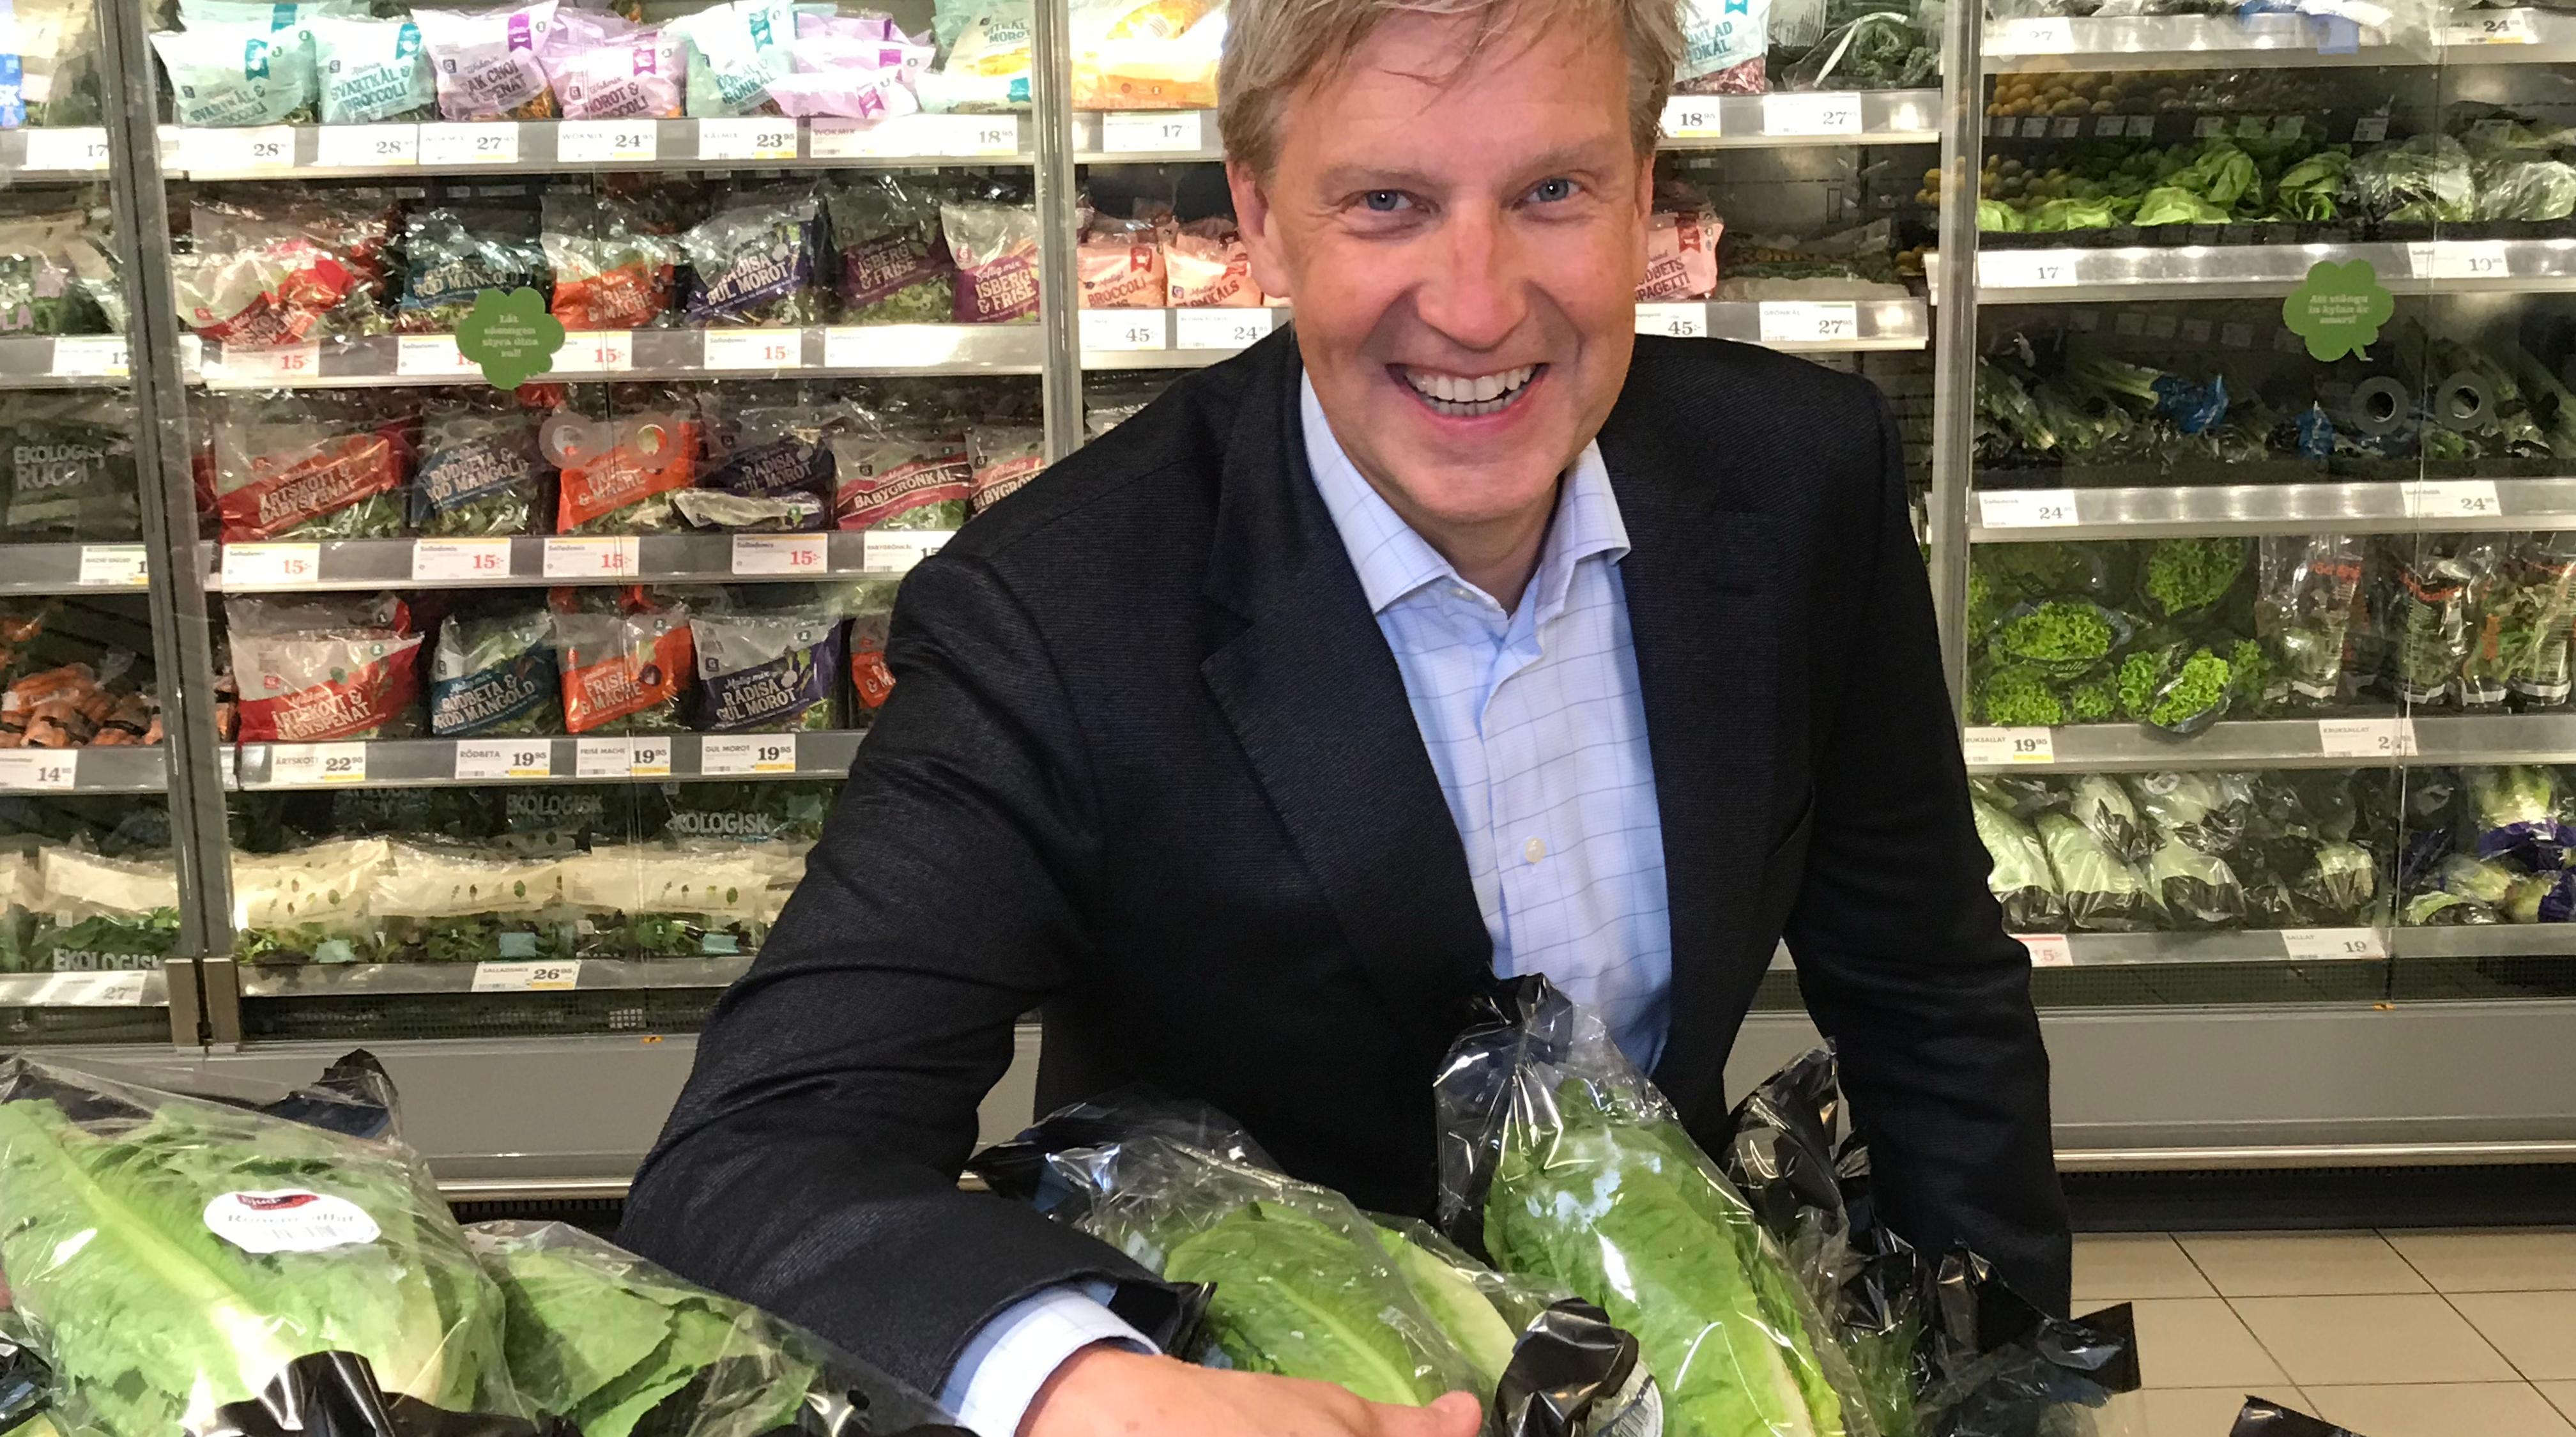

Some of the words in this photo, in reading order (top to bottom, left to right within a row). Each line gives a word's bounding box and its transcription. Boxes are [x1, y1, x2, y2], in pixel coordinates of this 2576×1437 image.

[2483, 19, 2510, 33] 24
[330, 67, 399, 102] SVARTKÅL
[628, 81, 640, 95] &
[1680, 112, 1703, 127] 18
[1822, 111, 1848, 125] 27
[978, 130, 1002, 144] 18
[1161, 125, 1183, 138] 17
[375, 140, 402, 155] 28
[475, 136, 503, 150] 27
[614, 133, 641, 148] 24
[756, 132, 783, 148] 23
[87, 144, 109, 158] 17
[253, 142, 280, 157] 28
[2036, 266, 2060, 280] 17
[706, 283, 737, 306] GUL
[735, 261, 789, 295] MOROT
[974, 268, 1032, 300] ISBERG
[1087, 276, 1147, 307] BROCCOLI
[2309, 294, 2327, 304] Att
[977, 298, 990, 314] &
[1233, 326, 1259, 341] 24
[1818, 319, 1843, 334] 27
[454, 458, 531, 493] MANGOLD
[765, 460, 813, 488] MOROT
[853, 468, 956, 509] BABYGRÖNKÅL
[2460, 497, 2487, 511] 24
[2038, 506, 2064, 520] 24
[348, 689, 362, 705] &
[441, 679, 505, 714] RÖDBETA
[503, 673, 518, 689] &
[721, 677, 781, 707] RADISA
[468, 679, 537, 722] MANGOLD
[716, 704, 746, 723] GUL
[745, 687, 797, 717] MOROT
[2014, 738, 2036, 753] 19
[460, 749, 501, 759] RÖDBETA
[511, 751, 535, 767] 19
[633, 749, 655, 764] 19
[757, 746, 780, 761] 19
[325, 757, 352, 772] 22
[37, 766, 61, 782] 14
[506, 794, 603, 816] EKOLOGISK
[664, 811, 771, 835] KOLOGISK
[2343, 941, 2367, 953] 19
[533, 968, 560, 980] 26
[102, 987, 126, 1001] 27
